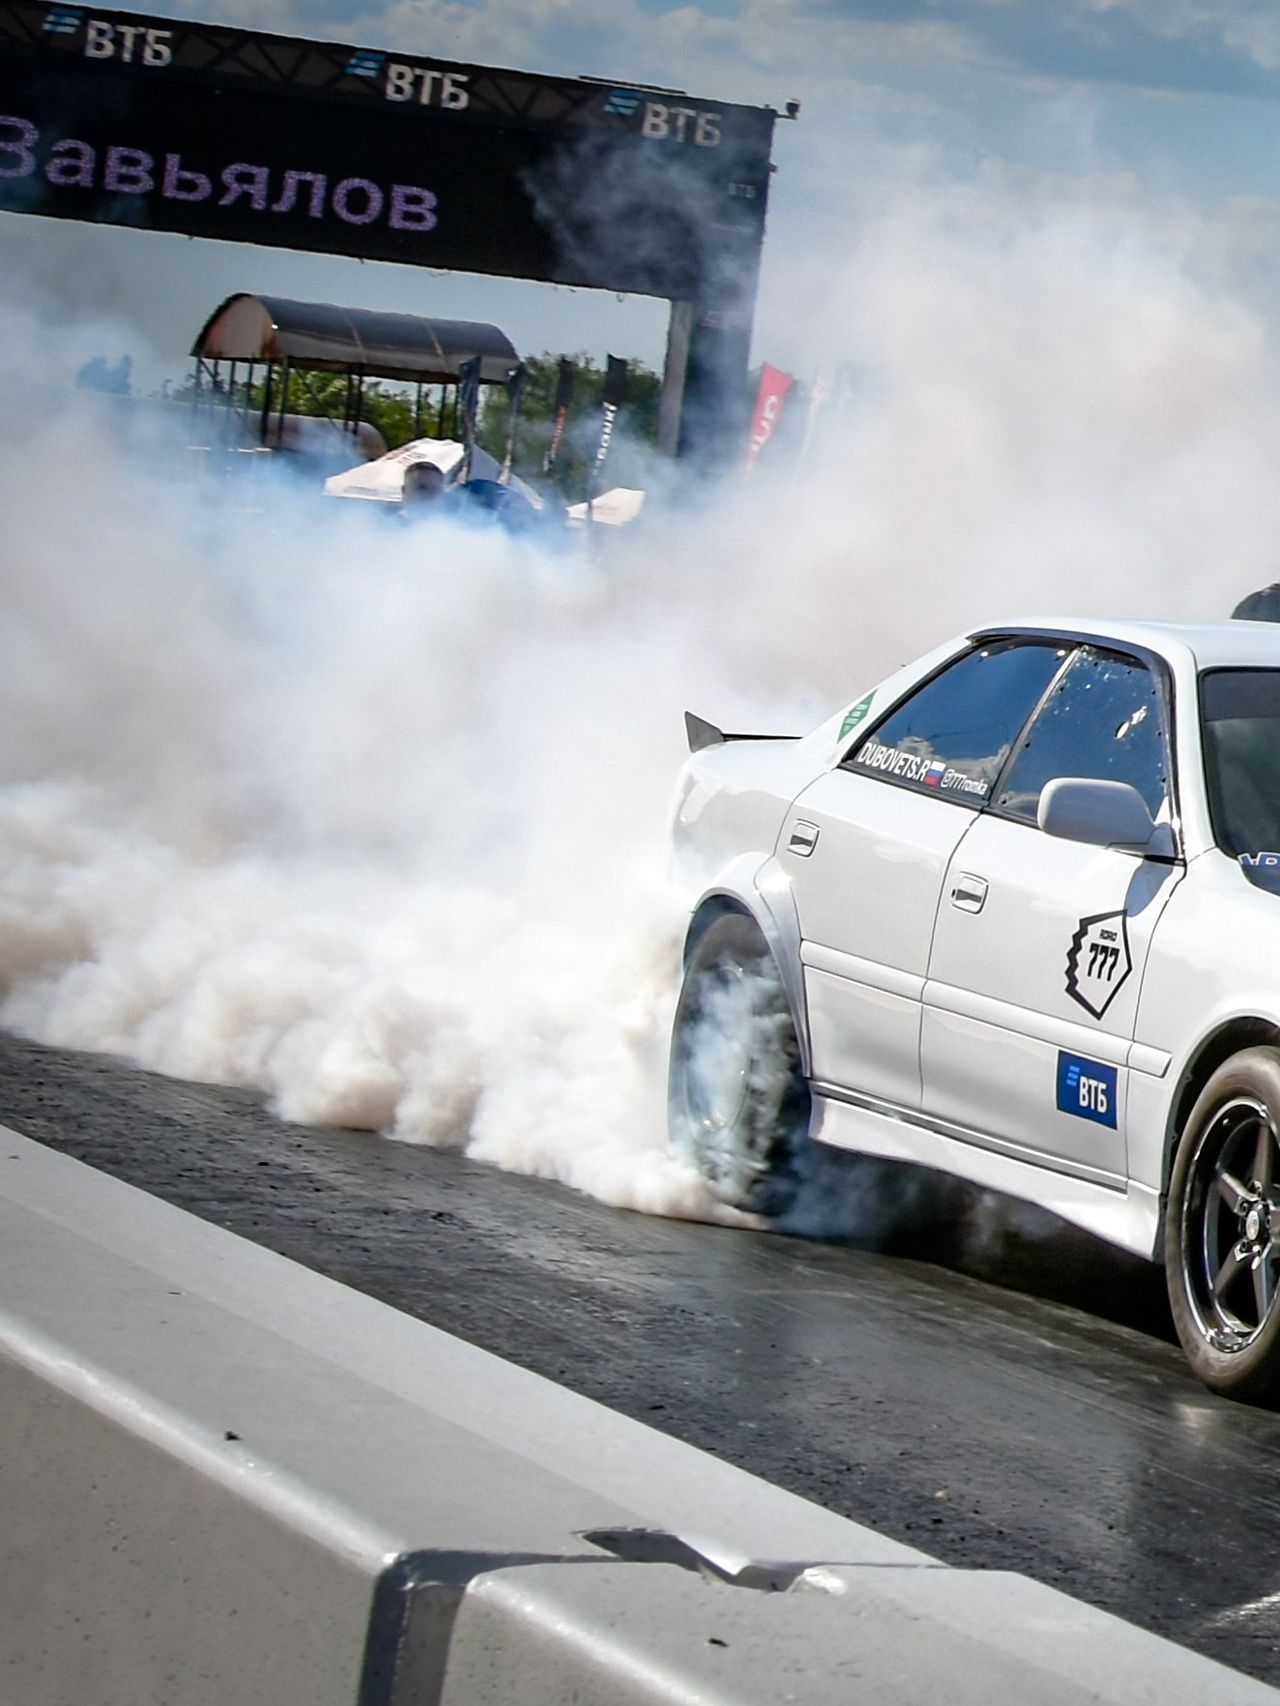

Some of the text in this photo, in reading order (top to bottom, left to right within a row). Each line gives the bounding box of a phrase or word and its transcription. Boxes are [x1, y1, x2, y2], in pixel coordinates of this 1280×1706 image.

[84, 20, 172, 67] ВТБ
[385, 62, 470, 111] ВТБ
[641, 101, 722, 147] ВТБ
[0, 114, 439, 232] Завьялов
[857, 741, 931, 782] DUBOVETS.R
[1087, 942, 1120, 982] 777
[1079, 1075, 1108, 1114] ВТБ
